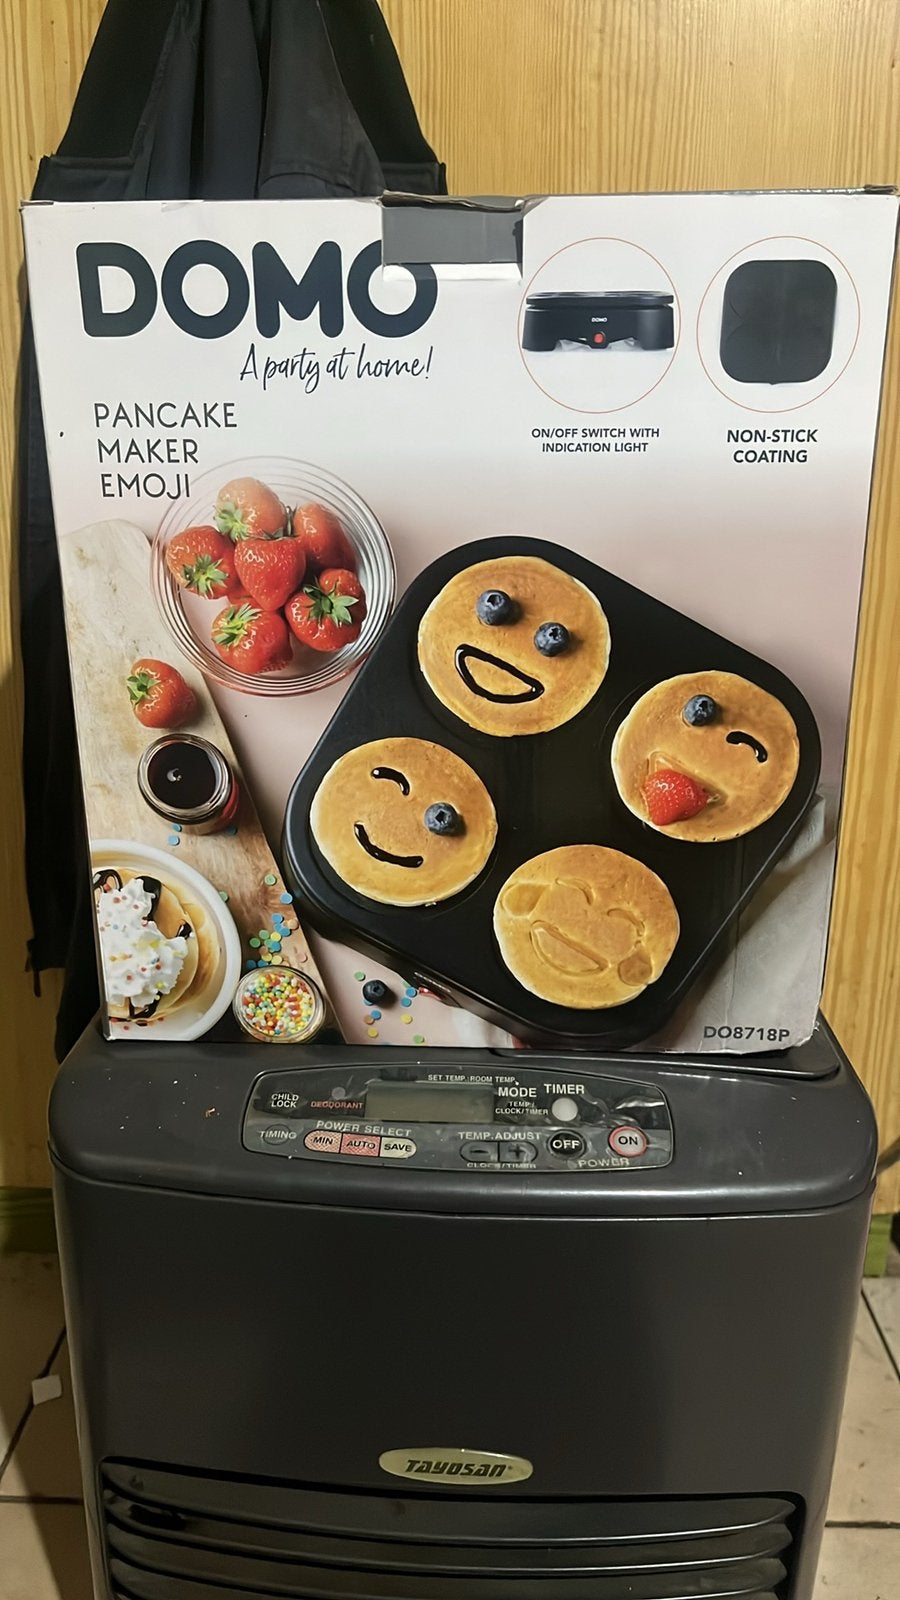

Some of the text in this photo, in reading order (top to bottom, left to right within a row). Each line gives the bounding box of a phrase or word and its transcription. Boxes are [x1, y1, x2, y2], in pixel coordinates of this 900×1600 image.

[76, 240, 438, 338] DOMO
[240, 343, 434, 394] A party at home!
[93, 402, 238, 429] PANCAKE
[531, 428, 660, 438] ON/OFF SWITCH WITH
[726, 429, 818, 443] NON-STICK
[98, 438, 199, 464] MAKER
[542, 442, 649, 452] INDICATION LIGHT
[733, 450, 808, 463] COATING
[101, 473, 191, 500] EMOJI
[703, 1026, 790, 1042] DO8718P
[470, 1075, 493, 1083] ROOM
[498, 1087, 537, 1098] MODE
[544, 1083, 585, 1095] TIMER
[271, 1093, 300, 1101] CHILD
[271, 1101, 297, 1109] LOCK
[316, 1120, 411, 1137] POWER SELECT
[260, 1130, 297, 1140] TIMING
[313, 1136, 334, 1145] MIN
[347, 1140, 376, 1150] AUTO
[552, 1139, 579, 1149] OFF
[618, 1136, 638, 1146] ON
[384, 1143, 412, 1152] SAVE
